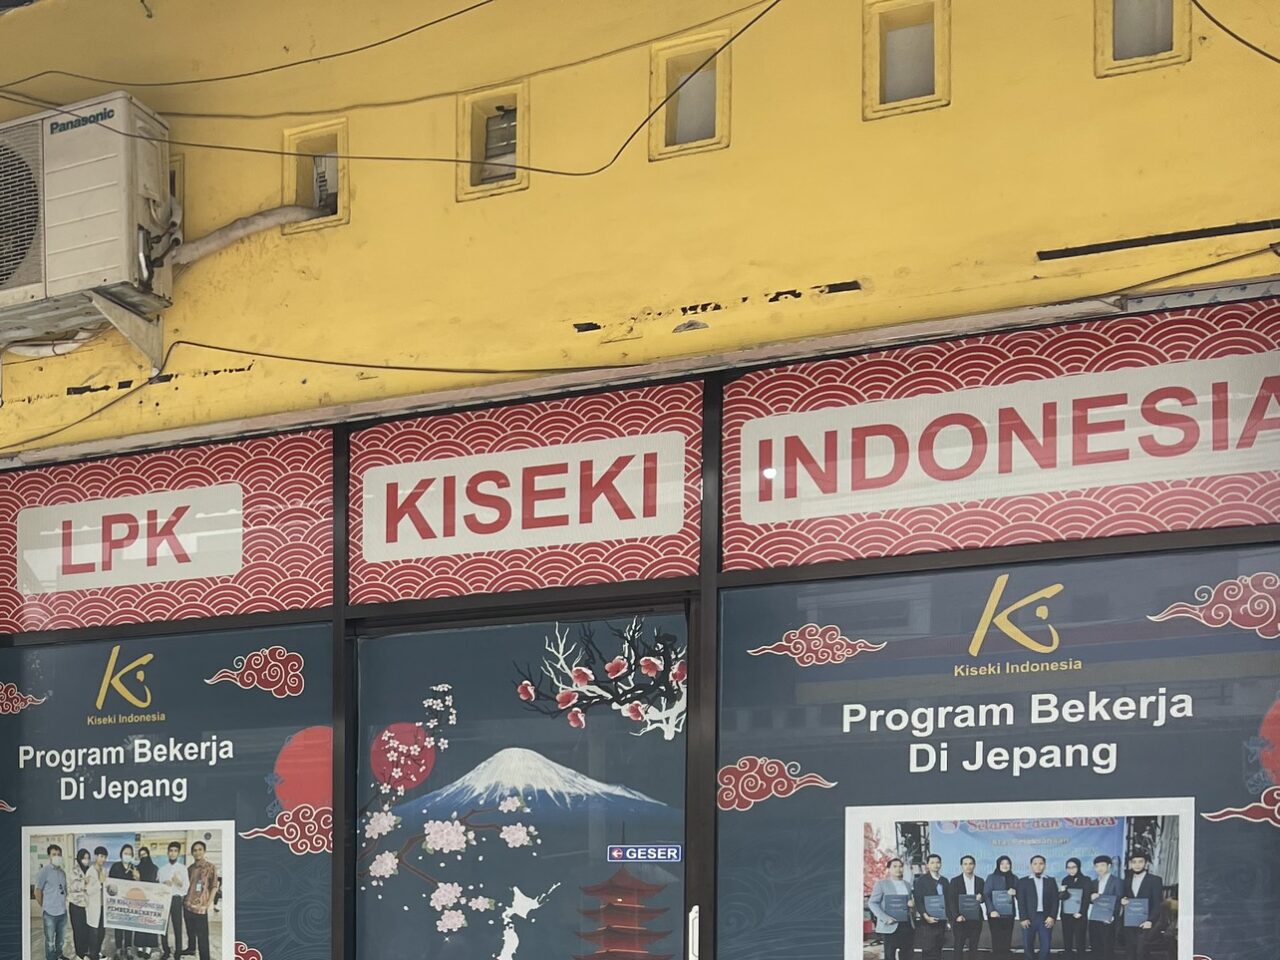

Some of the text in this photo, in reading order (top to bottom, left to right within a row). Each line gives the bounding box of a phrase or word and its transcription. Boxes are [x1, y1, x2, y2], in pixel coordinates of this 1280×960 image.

[49, 107, 115, 135] Panasonic
[758, 374, 1280, 503] INDONESIA
[386, 452, 658, 544] KISEKI
[61, 505, 192, 576] LPK
[953, 657, 1082, 677] Kiseki Indonesia
[87, 712, 166, 726] Kiseki Indonesia
[842, 687, 1194, 737] Program Bekerja
[19, 735, 234, 773] Program Bekerja
[909, 740, 1117, 777] Di Jepang
[60, 776, 188, 804] Di Jepang
[626, 847, 678, 860] GESER
